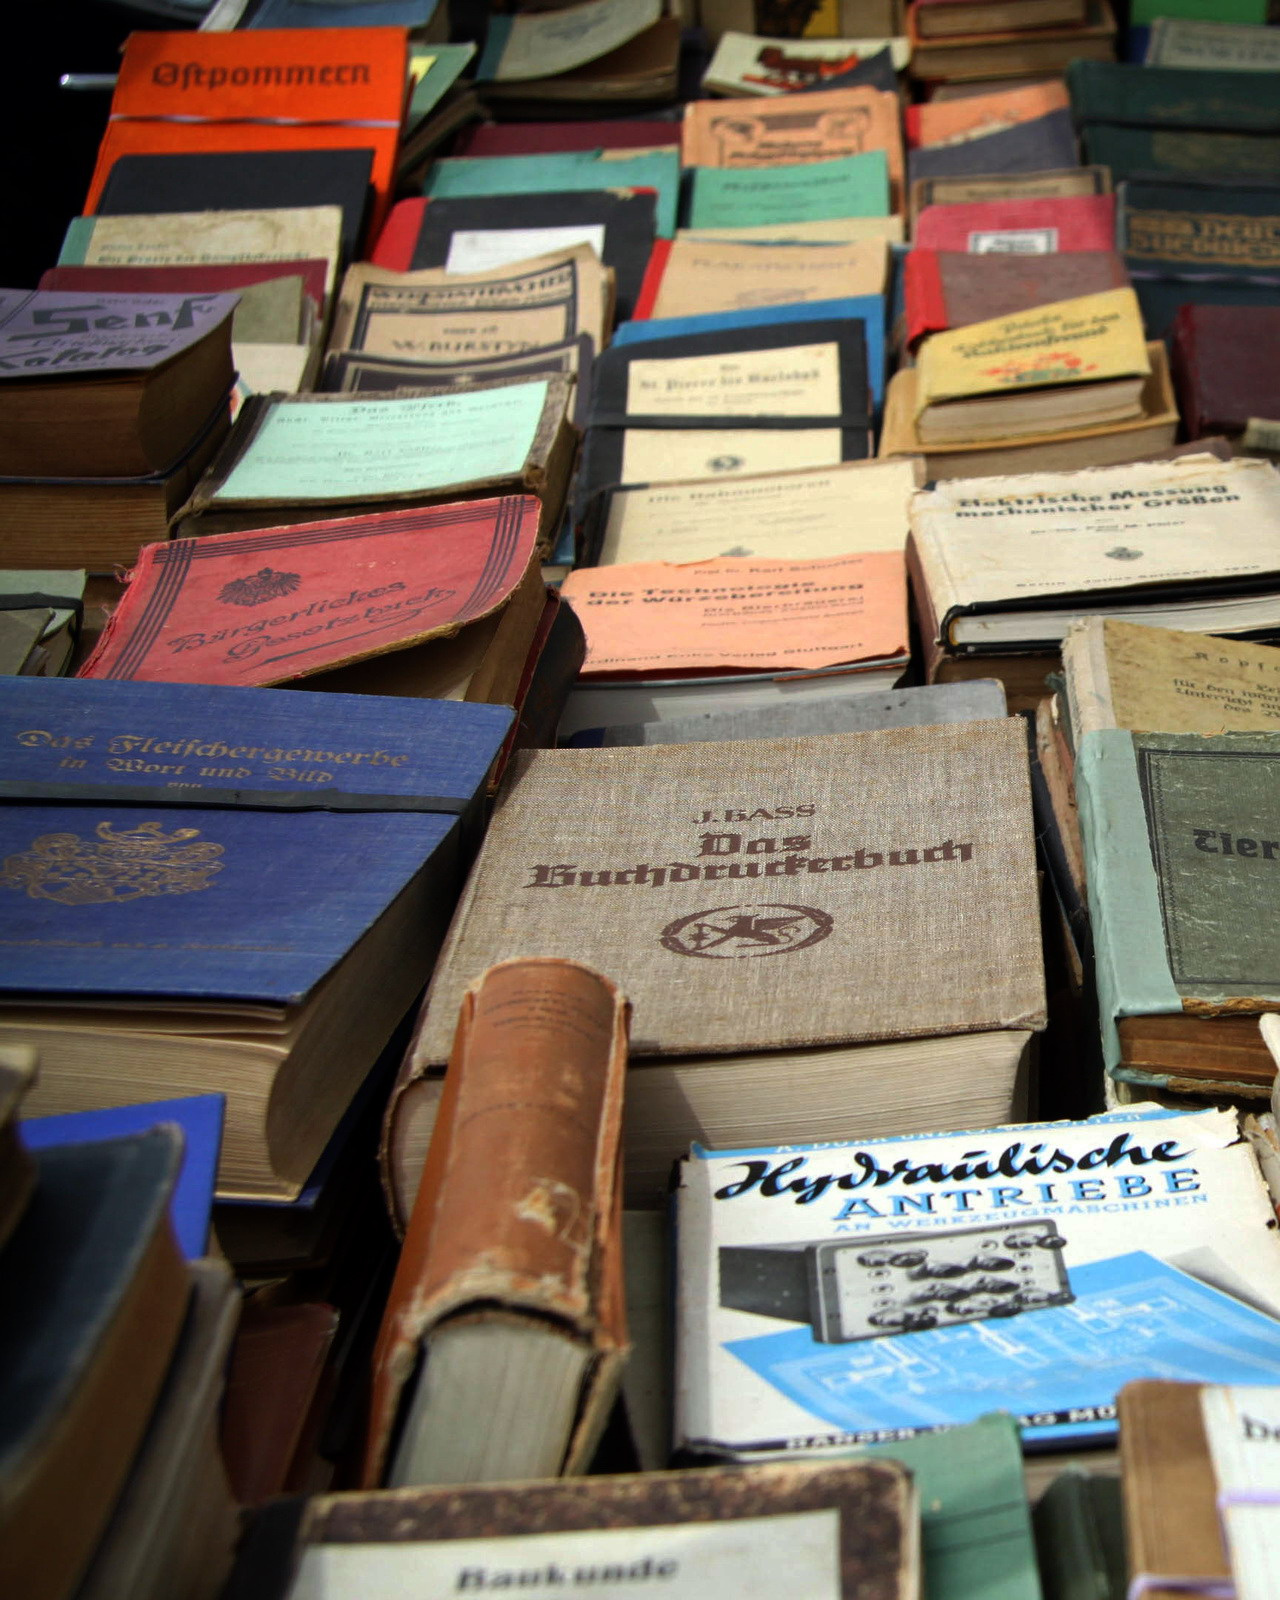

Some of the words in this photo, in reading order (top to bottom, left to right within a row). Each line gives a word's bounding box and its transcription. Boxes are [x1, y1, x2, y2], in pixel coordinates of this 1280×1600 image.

[152, 61, 373, 91] Ostpommern
[7, 294, 219, 342] Senf
[956, 502, 1133, 519] mechanischer
[959, 492, 1103, 508] Elektrische
[1110, 484, 1229, 501] Messung
[166, 578, 407, 657] Bürgerliches
[223, 585, 458, 665] Gesetzbuch
[16, 728, 97, 749] Das
[59, 754, 89, 770] in
[106, 756, 189, 782] Wort
[199, 764, 253, 782] und
[523, 838, 976, 889] Buchdruckerbuch
[696, 831, 812, 859] Das
[714, 1132, 1197, 1205] Hydraulische
[832, 1167, 1202, 1221] ANTRIEBE
[833, 1223, 872, 1234] AN
[888, 1194, 1210, 1229] WERKZEUGMASCHINEN
[453, 1555, 679, 1594] Baukunde
